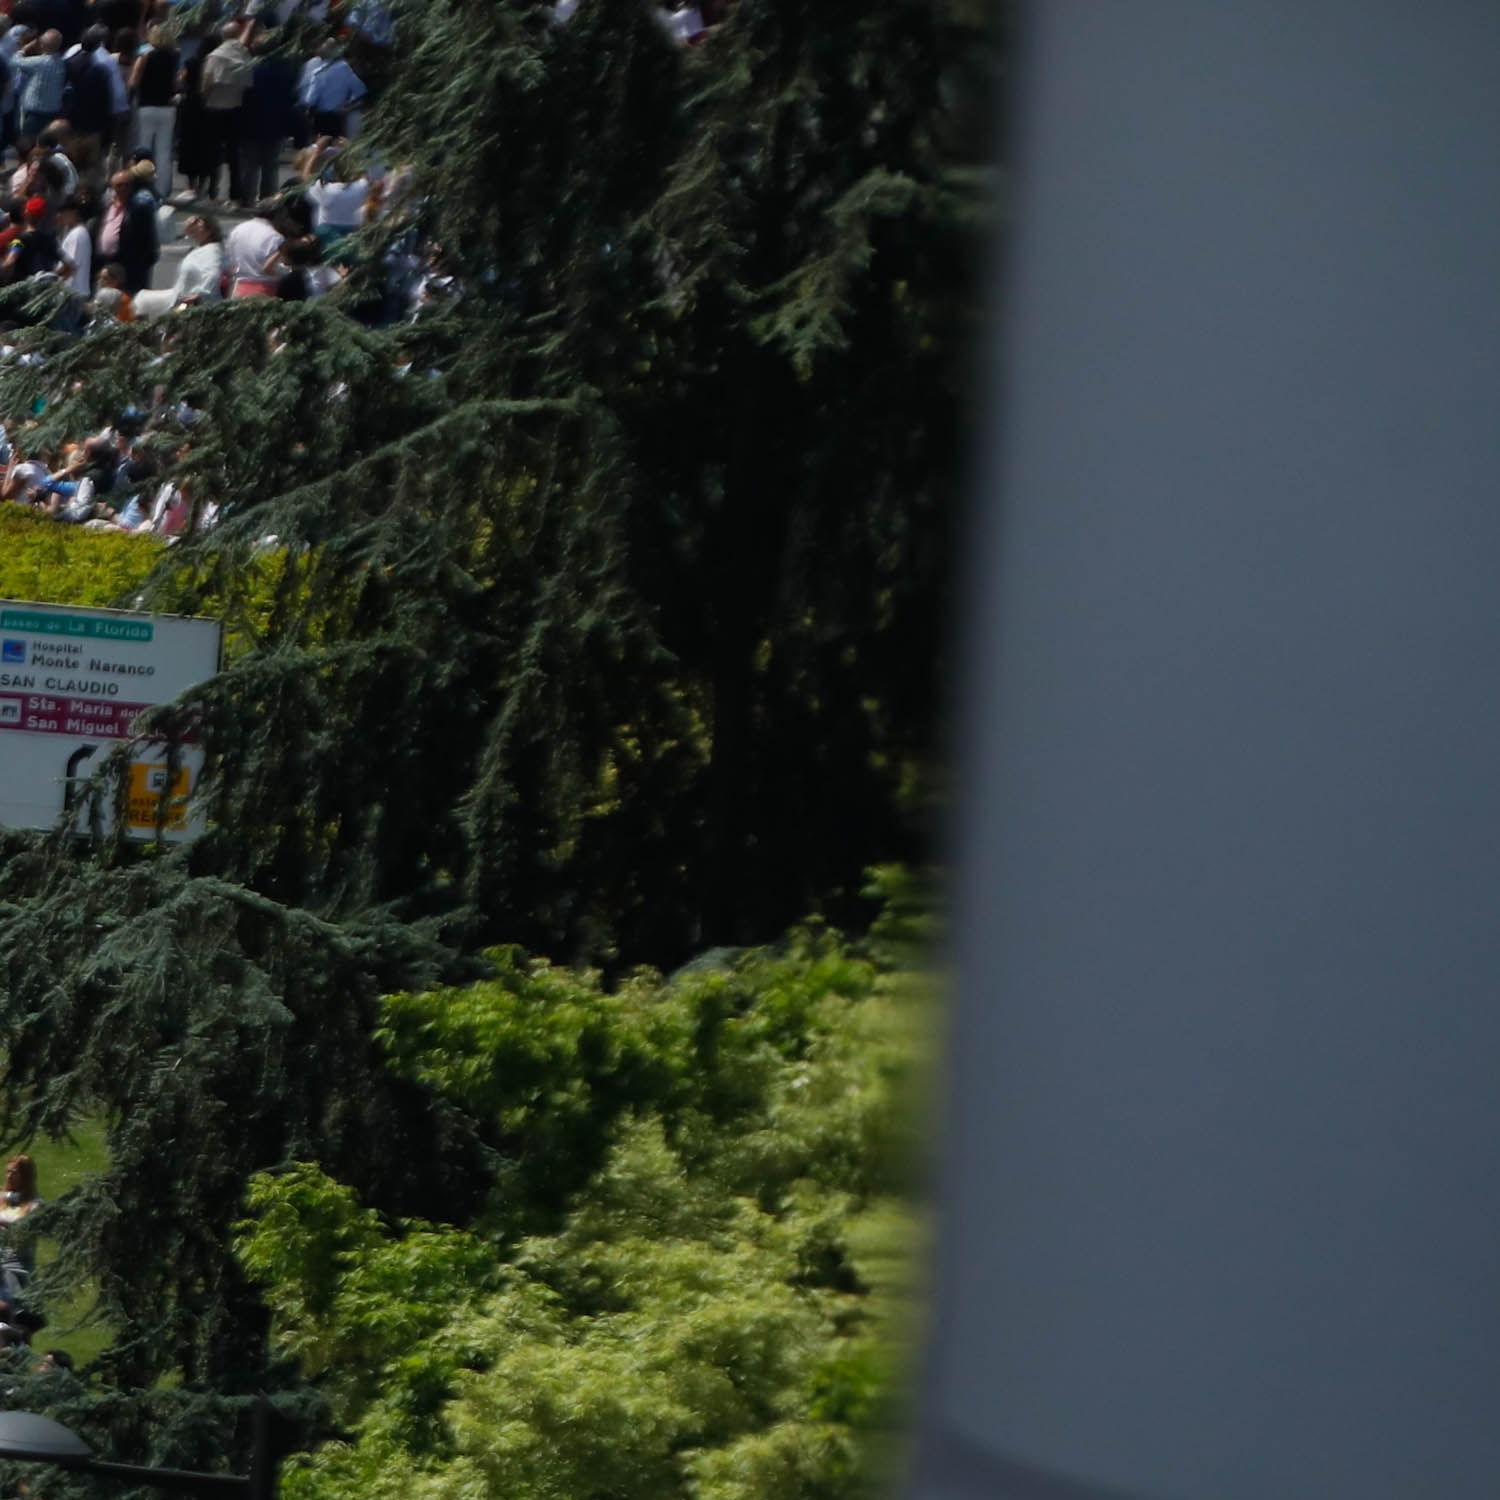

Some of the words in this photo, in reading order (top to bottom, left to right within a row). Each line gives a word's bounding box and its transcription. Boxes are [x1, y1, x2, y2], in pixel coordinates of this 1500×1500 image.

[68, 621, 85, 632] La
[95, 622, 150, 638] Florida
[32, 640, 83, 654] Hospital
[32, 655, 80, 669] Monte
[90, 659, 156, 676] Naranco
[0, 674, 35, 688] SAN
[45, 677, 120, 695] CLAUDIO
[28, 697, 61, 711] Sta.
[26, 715, 58, 729] San
[65, 718, 119, 735] Miguel
